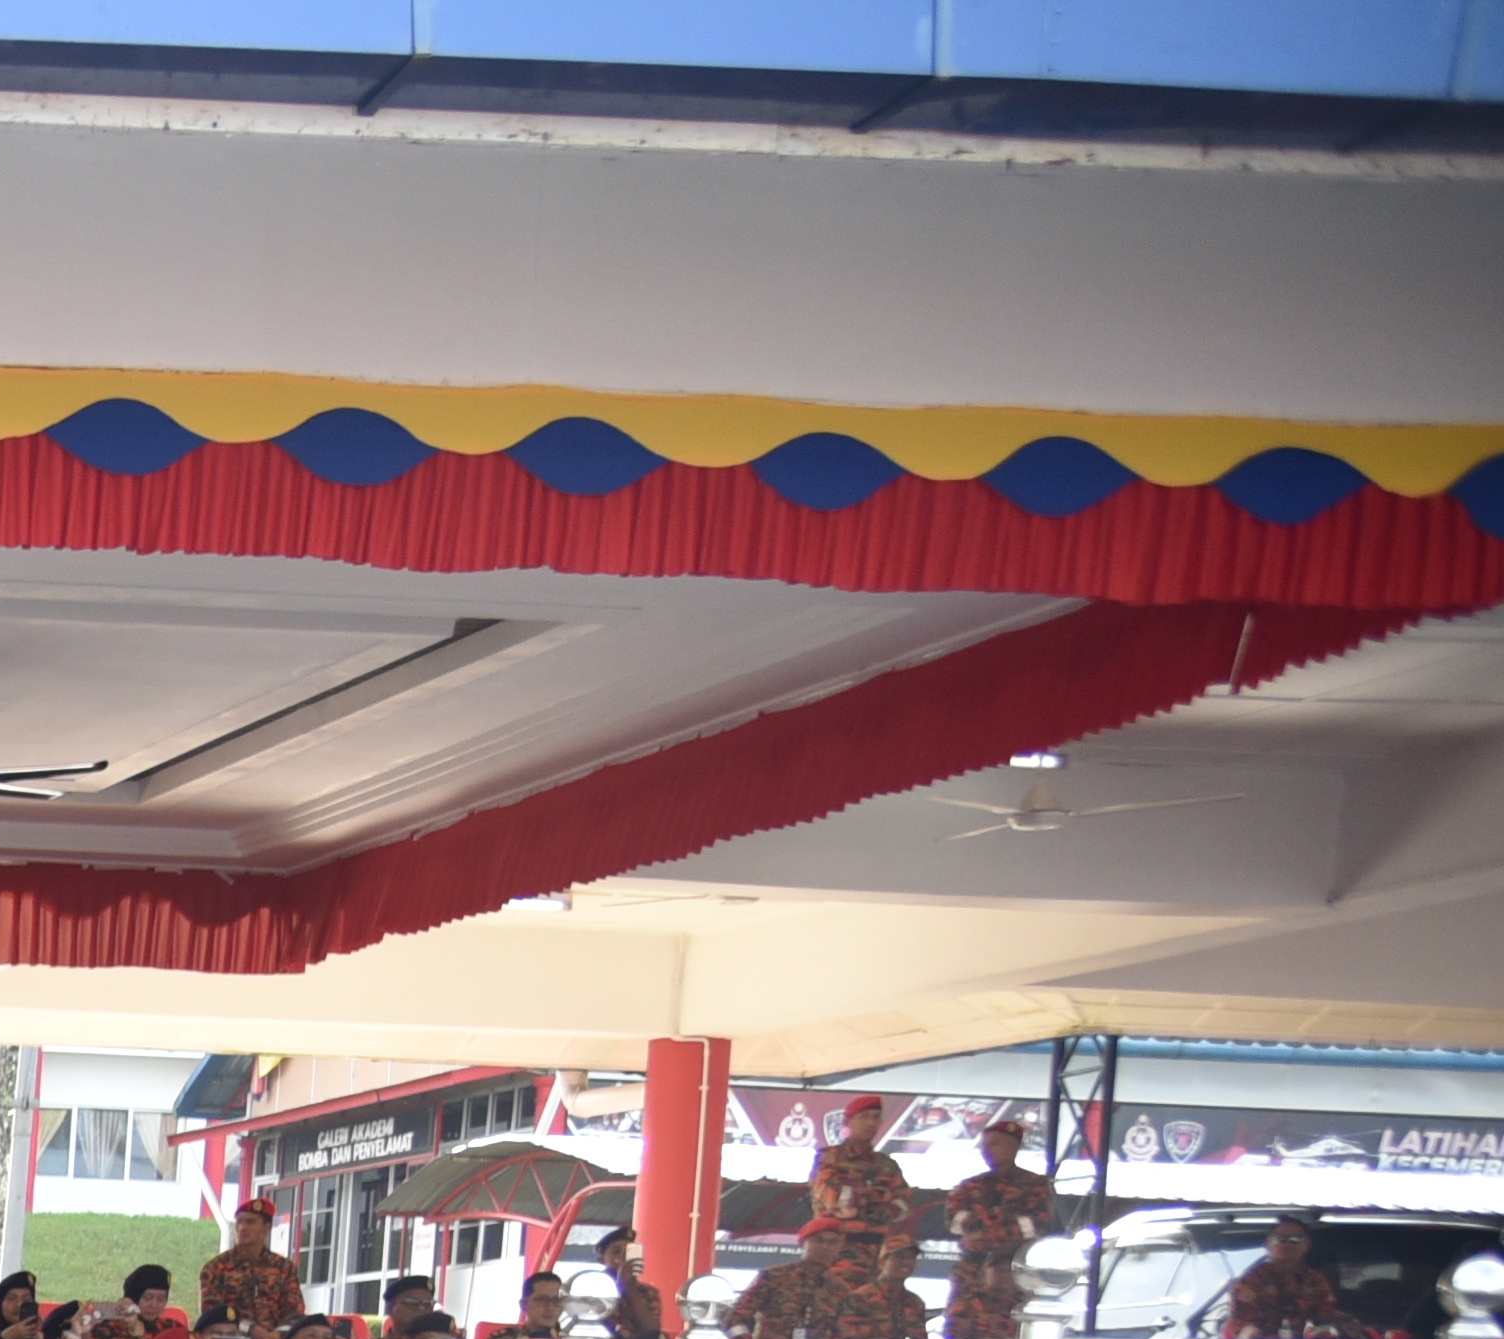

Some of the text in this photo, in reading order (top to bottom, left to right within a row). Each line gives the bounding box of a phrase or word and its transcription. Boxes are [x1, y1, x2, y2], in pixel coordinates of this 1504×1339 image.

[317, 1117, 394, 1150] GALERI AKADEMI
[1378, 1129, 1504, 1158] LATIHA
[298, 1131, 414, 1172] BOMBA DAN PENYELAMAT
[1377, 1155, 1504, 1174] KECEMER
